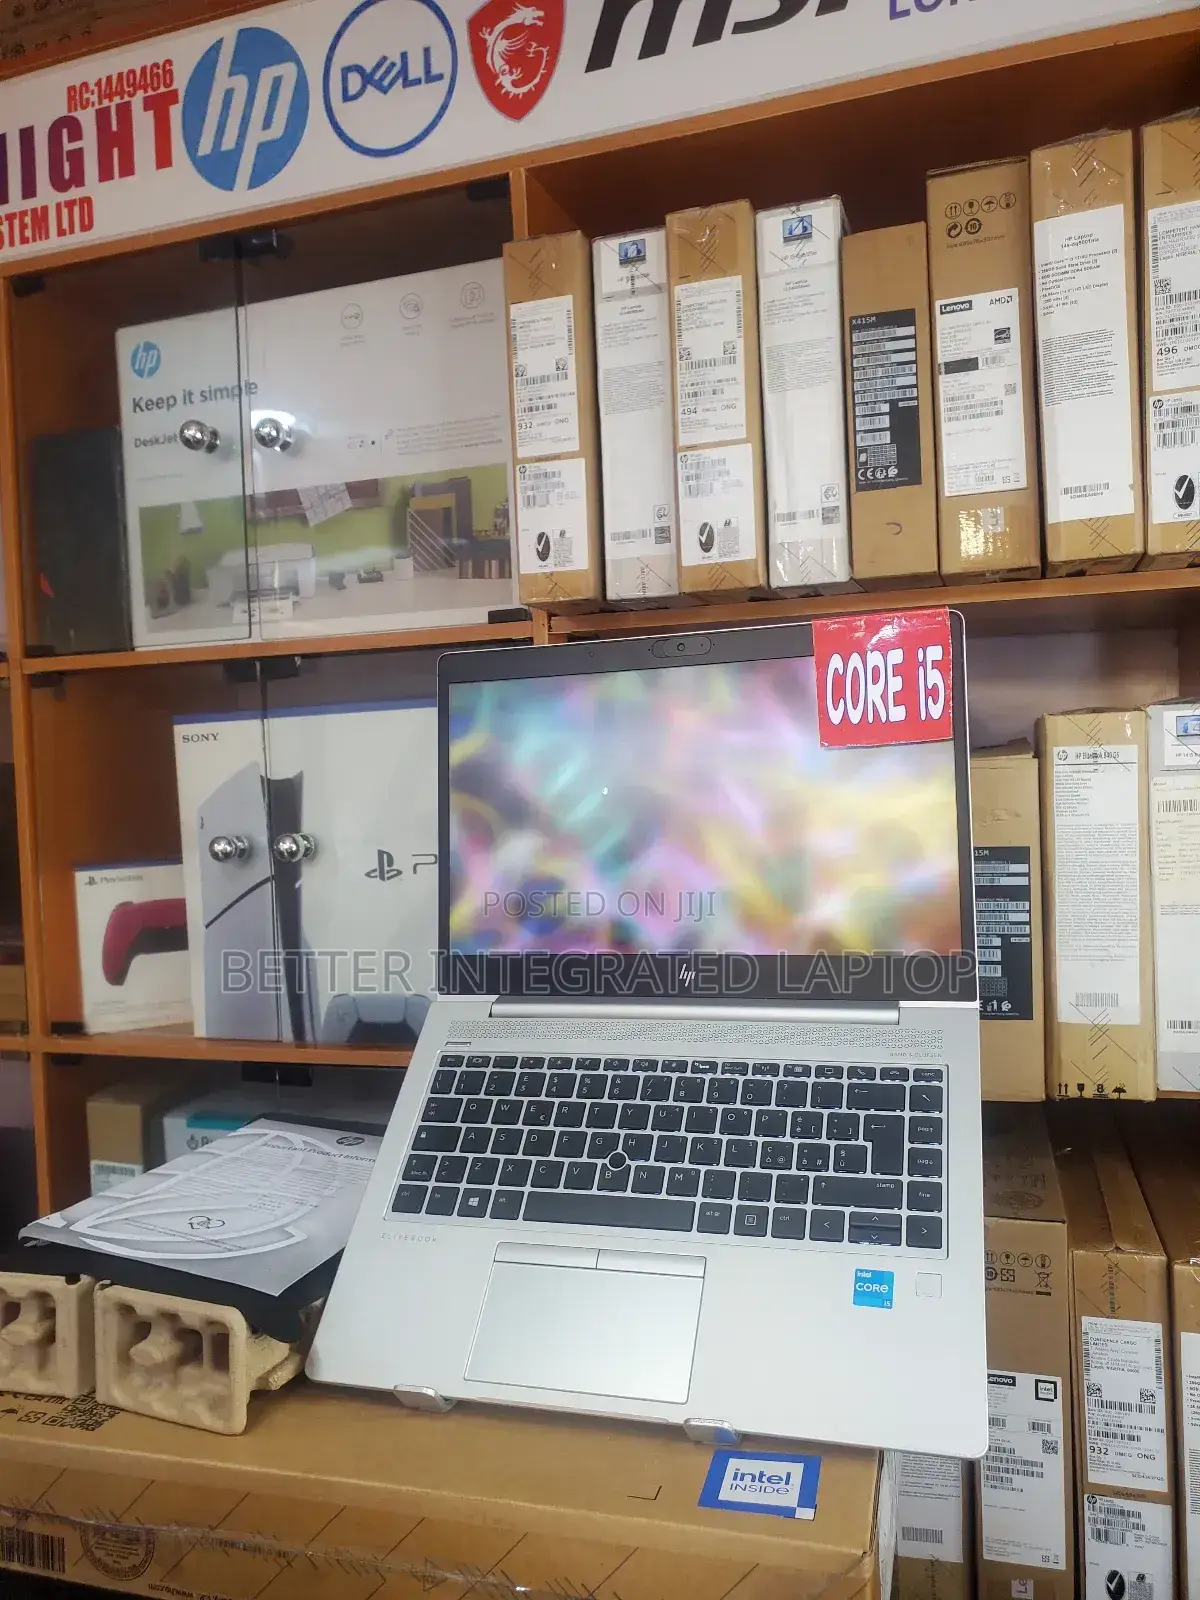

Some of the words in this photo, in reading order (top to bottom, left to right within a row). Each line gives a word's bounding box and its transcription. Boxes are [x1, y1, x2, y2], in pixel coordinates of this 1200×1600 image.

[341, 46, 444, 104] DELL
[66, 58, 174, 114] RC:1449466
[55, 196, 95, 238] LTD
[941, 303, 970, 314] Lenovo
[988, 297, 1007, 307] AMD
[851, 315, 877, 326] X415M
[1156, 345, 1178, 357] 496
[131, 391, 178, 414] Keep
[182, 388, 195, 406] it
[199, 379, 259, 404] simple
[680, 406, 698, 417] 494
[720, 402, 737, 412] ONG
[517, 422, 533, 432] 932
[825, 647, 908, 727] CORE
[917, 644, 946, 722] i5
[180, 732, 220, 745] SONY
[262, 1142, 306, 1153] Important
[307, 1147, 344, 1158] Product
[857, 1270, 872, 1278] intel
[1089, 1445, 1109, 1456] 932
[1136, 1452, 1156, 1461] ONG
[732, 1467, 793, 1486] intel
